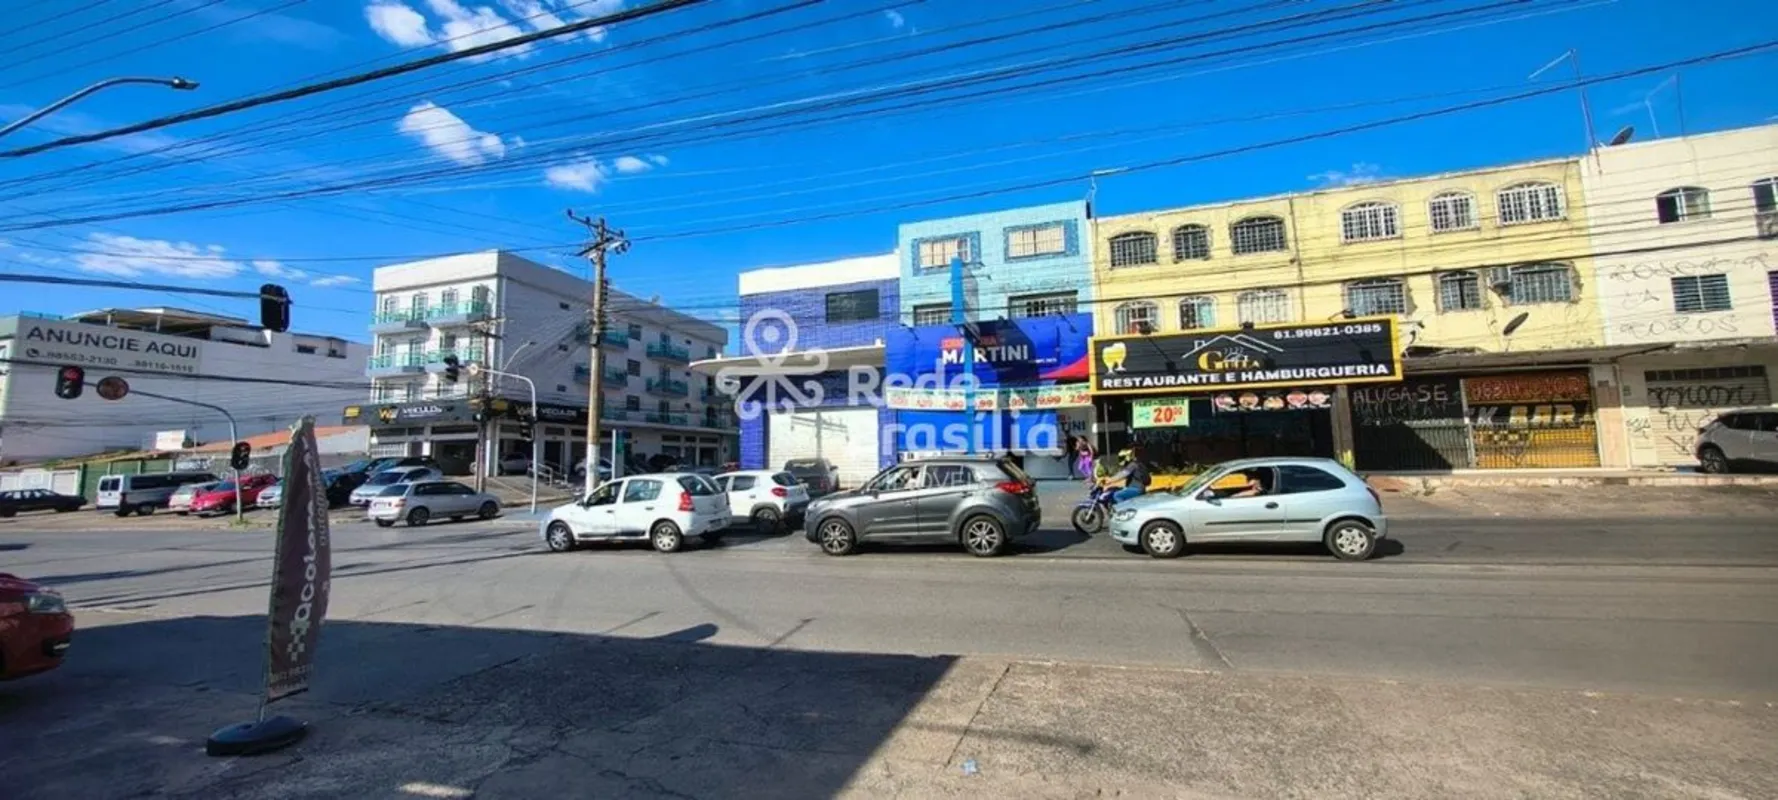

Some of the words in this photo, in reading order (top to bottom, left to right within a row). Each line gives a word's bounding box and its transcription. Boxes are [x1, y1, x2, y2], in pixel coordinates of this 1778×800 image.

[27, 326, 140, 352] ANUNCIE
[145, 341, 197, 359] AQUI
[1102, 374, 1220, 388] RESTAURANTE
[1225, 372, 1236, 382] E
[1241, 364, 1389, 381] HAMBURGUERIA
